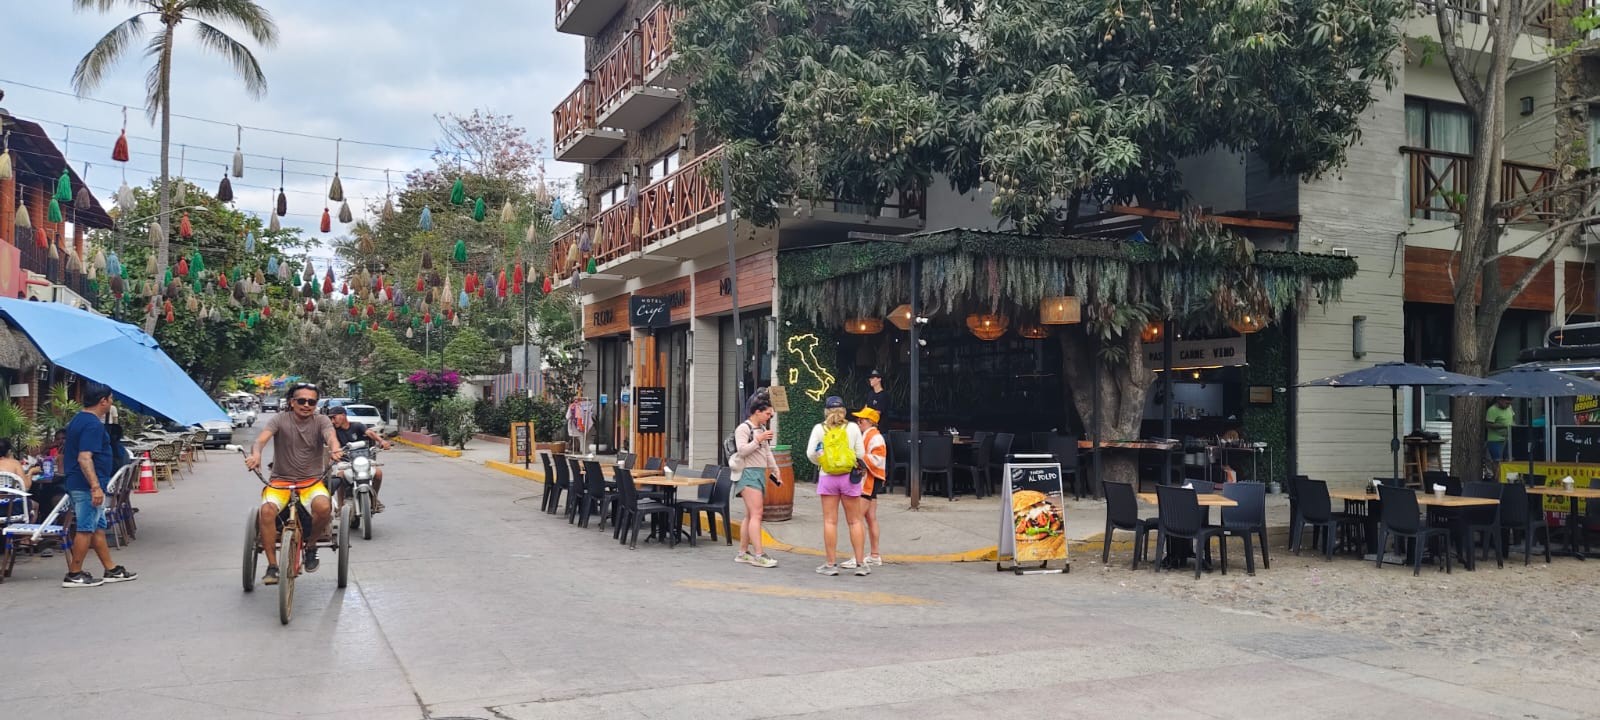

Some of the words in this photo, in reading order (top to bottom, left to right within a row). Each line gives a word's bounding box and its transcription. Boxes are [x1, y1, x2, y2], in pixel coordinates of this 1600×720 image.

[1180, 349, 1205, 360] CARNE
[1213, 346, 1235, 358] VINO
[1037, 473, 1057, 481] POLPO
